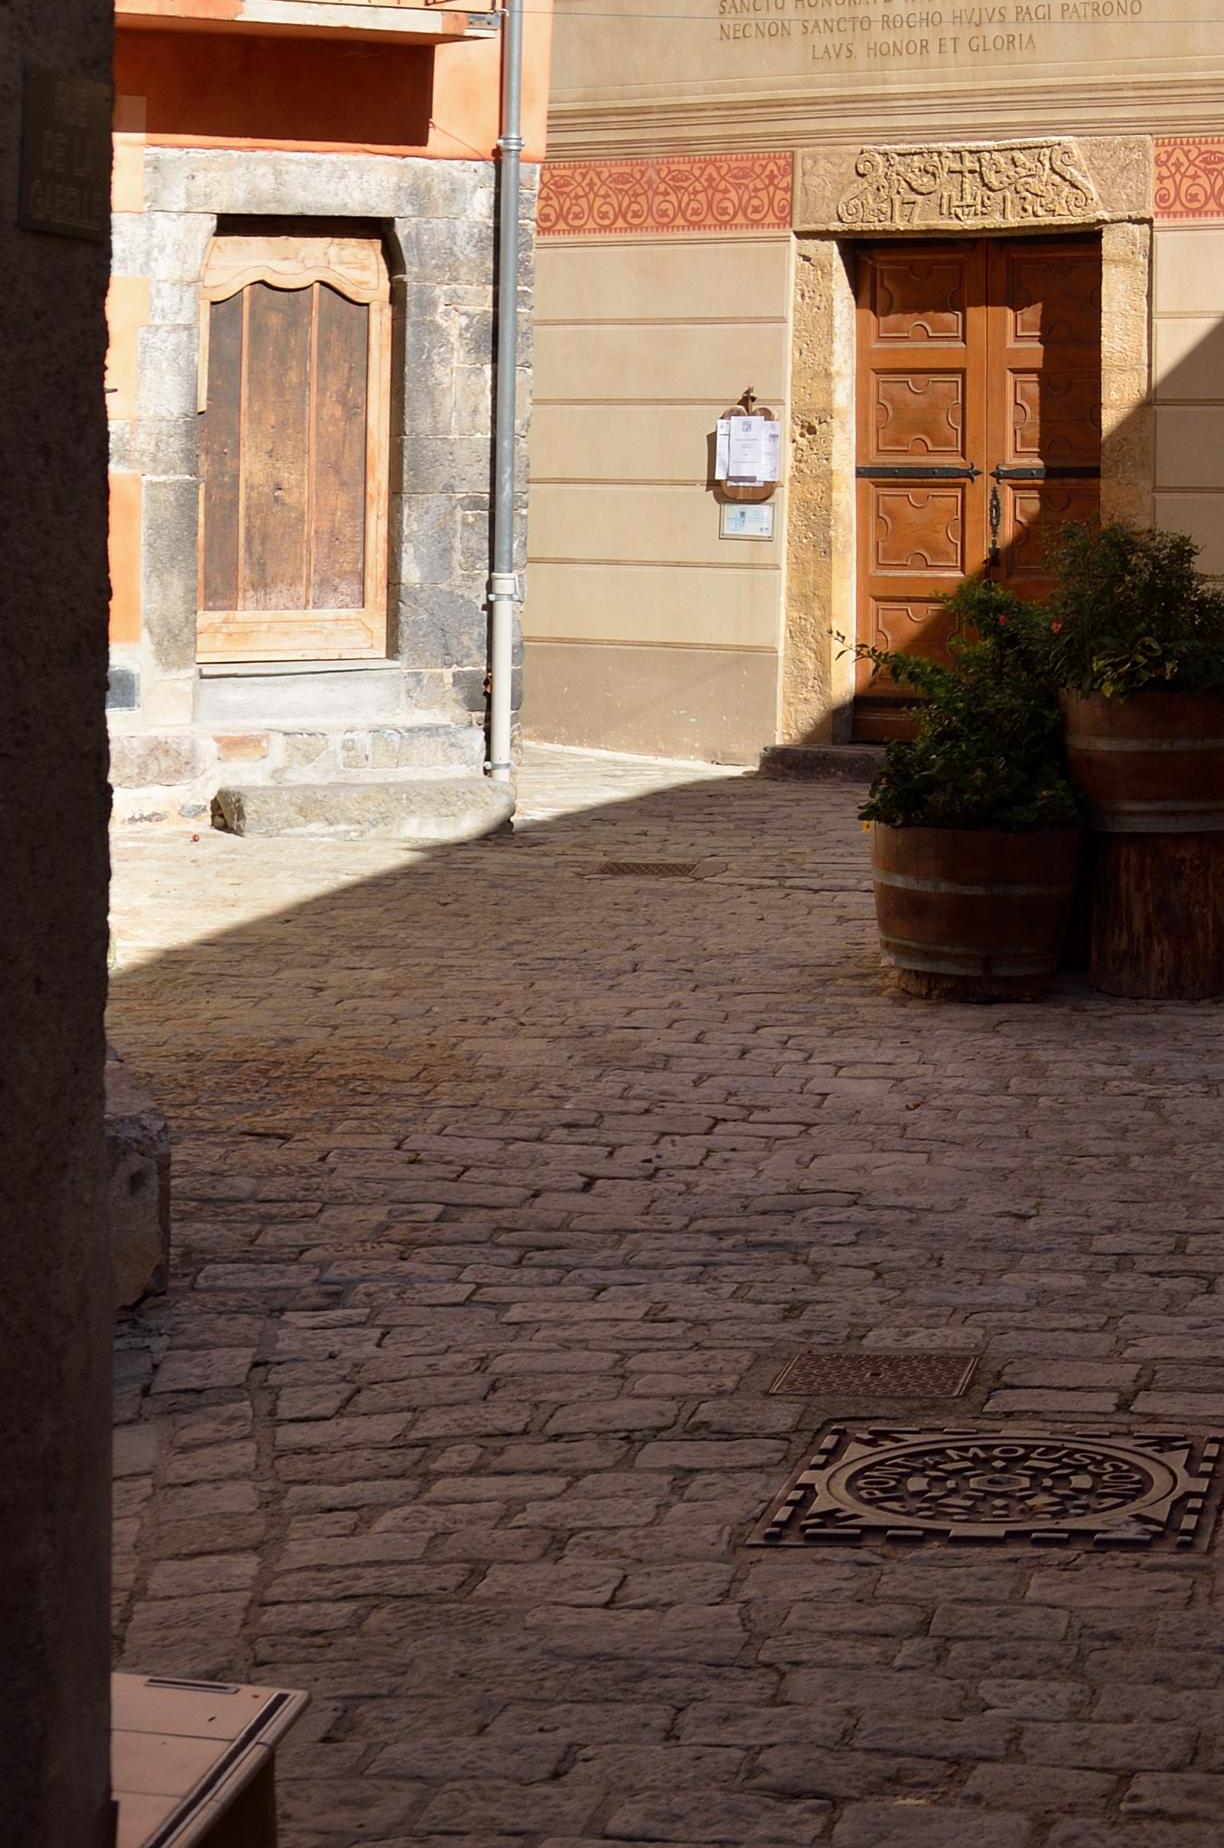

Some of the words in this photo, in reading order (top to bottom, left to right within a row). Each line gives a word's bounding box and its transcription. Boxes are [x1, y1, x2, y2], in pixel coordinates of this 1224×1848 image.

[719, 20, 792, 41] NECNON
[801, 16, 872, 36] SANCTO
[881, 10, 943, 32] ROCHO
[952, 6, 1007, 28] HVJVS
[1015, 3, 1052, 23] PAGI
[867, 38, 930, 59] HONOR
[938, 36, 961, 55] ET
[968, 33, 1037, 53] GLORIA
[42, 130, 68, 173] DE
[855, 1456, 926, 1501] PONT
[944, 1445, 1144, 1498] MOUSSON
